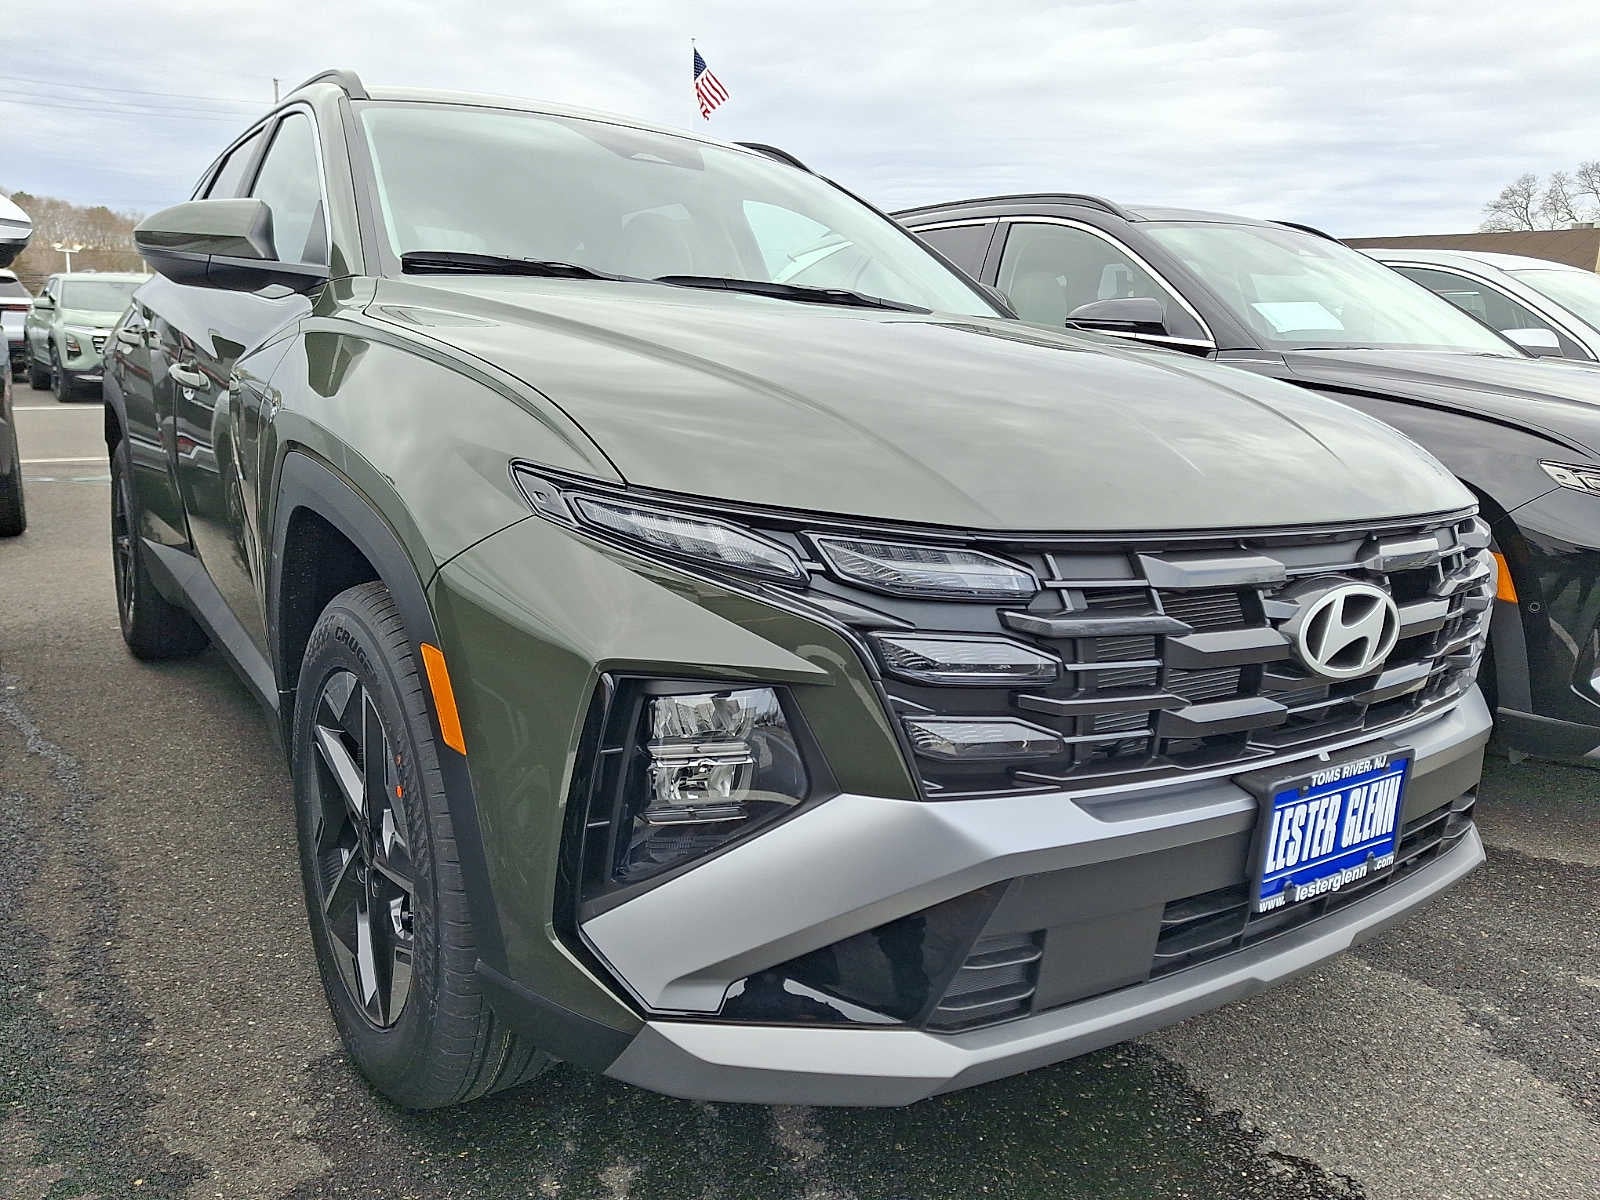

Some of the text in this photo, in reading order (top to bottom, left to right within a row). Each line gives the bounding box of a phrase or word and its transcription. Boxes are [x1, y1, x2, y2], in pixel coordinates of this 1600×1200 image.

[1311, 755, 1388, 788] TOMS RIVER, NJ
[1265, 775, 1401, 874] LESTER GLENN
[1294, 865, 1368, 902] lesterglenn
